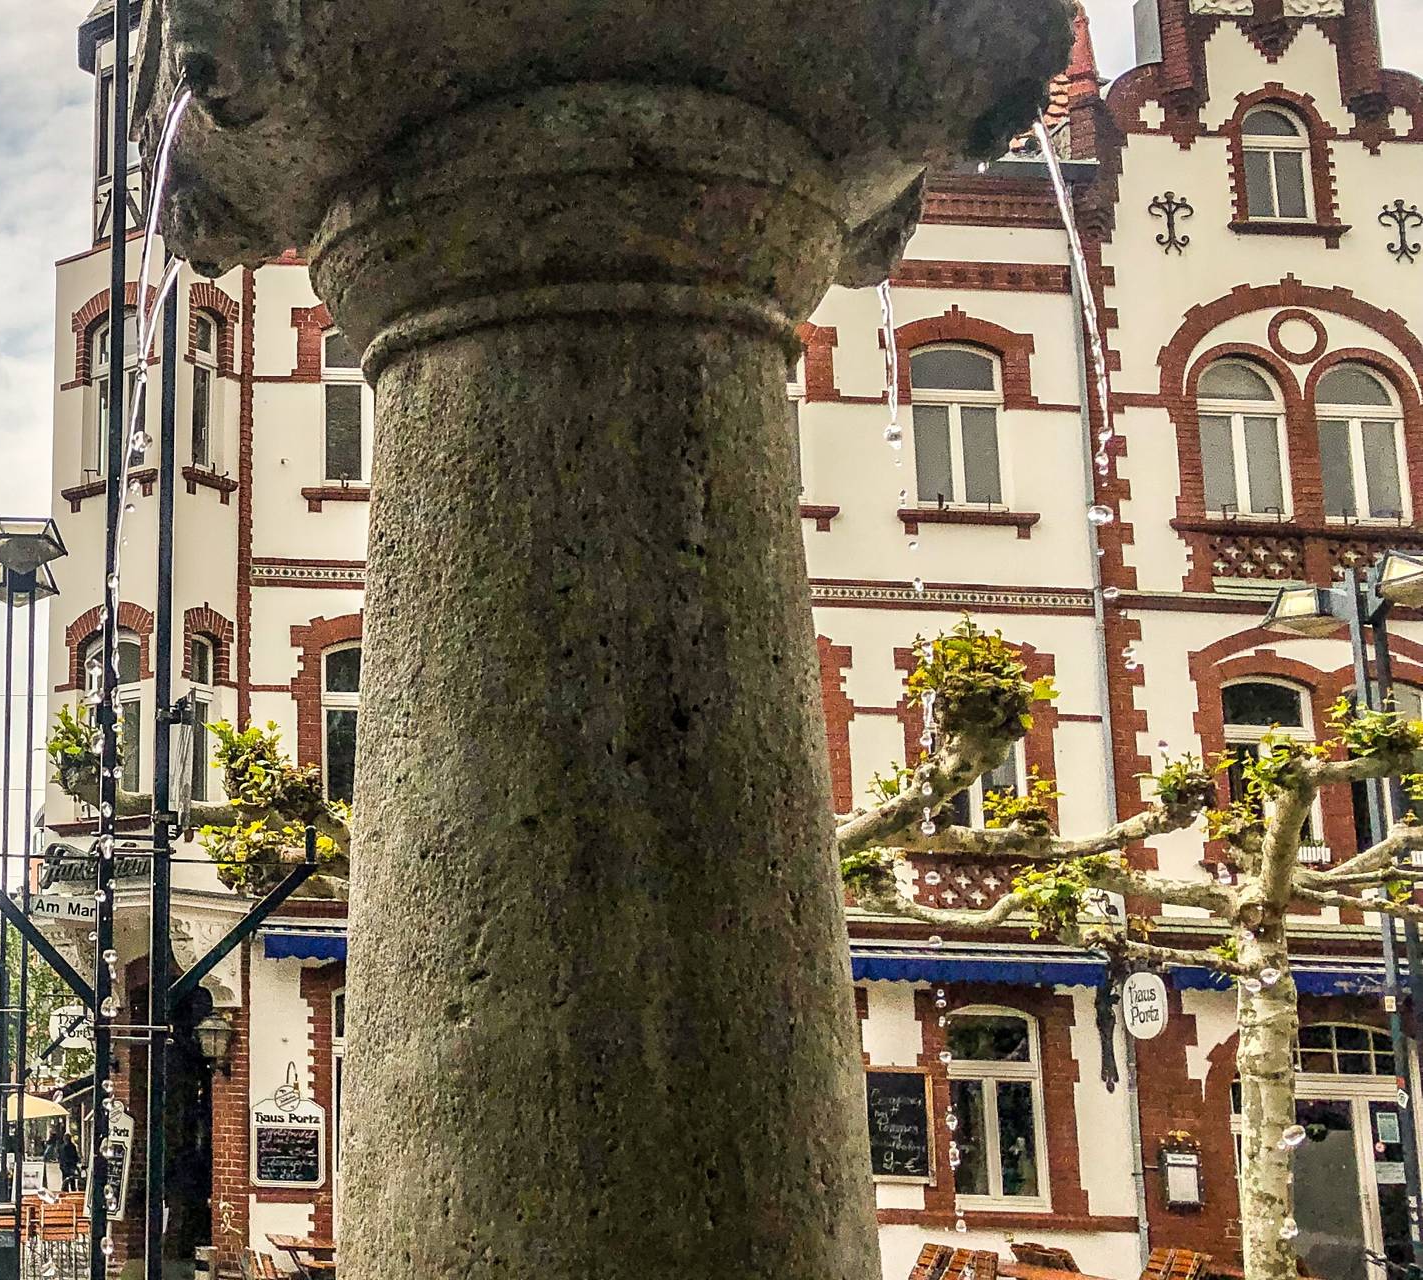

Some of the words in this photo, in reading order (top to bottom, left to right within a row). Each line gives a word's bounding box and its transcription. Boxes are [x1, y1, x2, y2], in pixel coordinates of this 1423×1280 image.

[35, 899, 59, 913] Am
[68, 902, 97, 917] Mar
[1130, 1004, 1160, 1026] Portz
[288, 1113, 321, 1124] Portz
